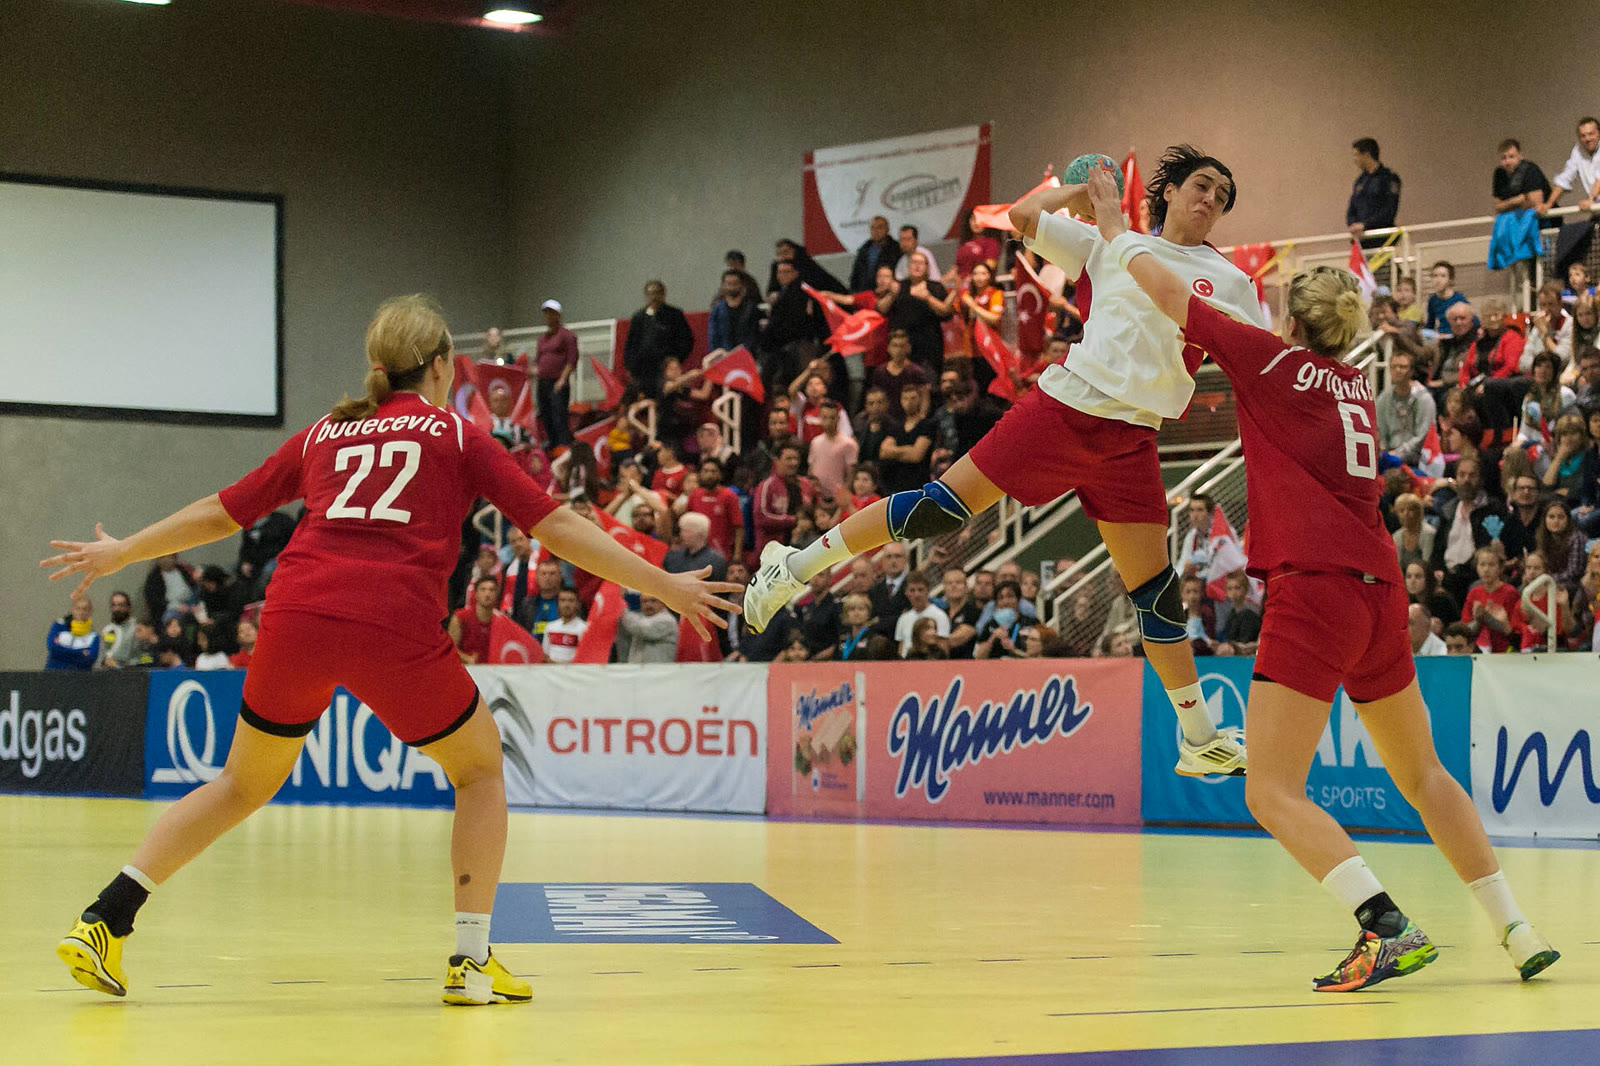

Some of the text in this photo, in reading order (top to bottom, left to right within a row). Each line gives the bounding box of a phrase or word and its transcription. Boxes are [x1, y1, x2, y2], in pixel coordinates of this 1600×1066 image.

[315, 414, 447, 444] budecevic
[1337, 401, 1377, 480] 6
[326, 440, 422, 524] 22
[0, 690, 87, 778] dgas
[292, 694, 449, 792] NIQA
[888, 674, 1093, 803] Manner
[983, 790, 1115, 809] www.manner.com
[1320, 784, 1386, 810] SPORTS
